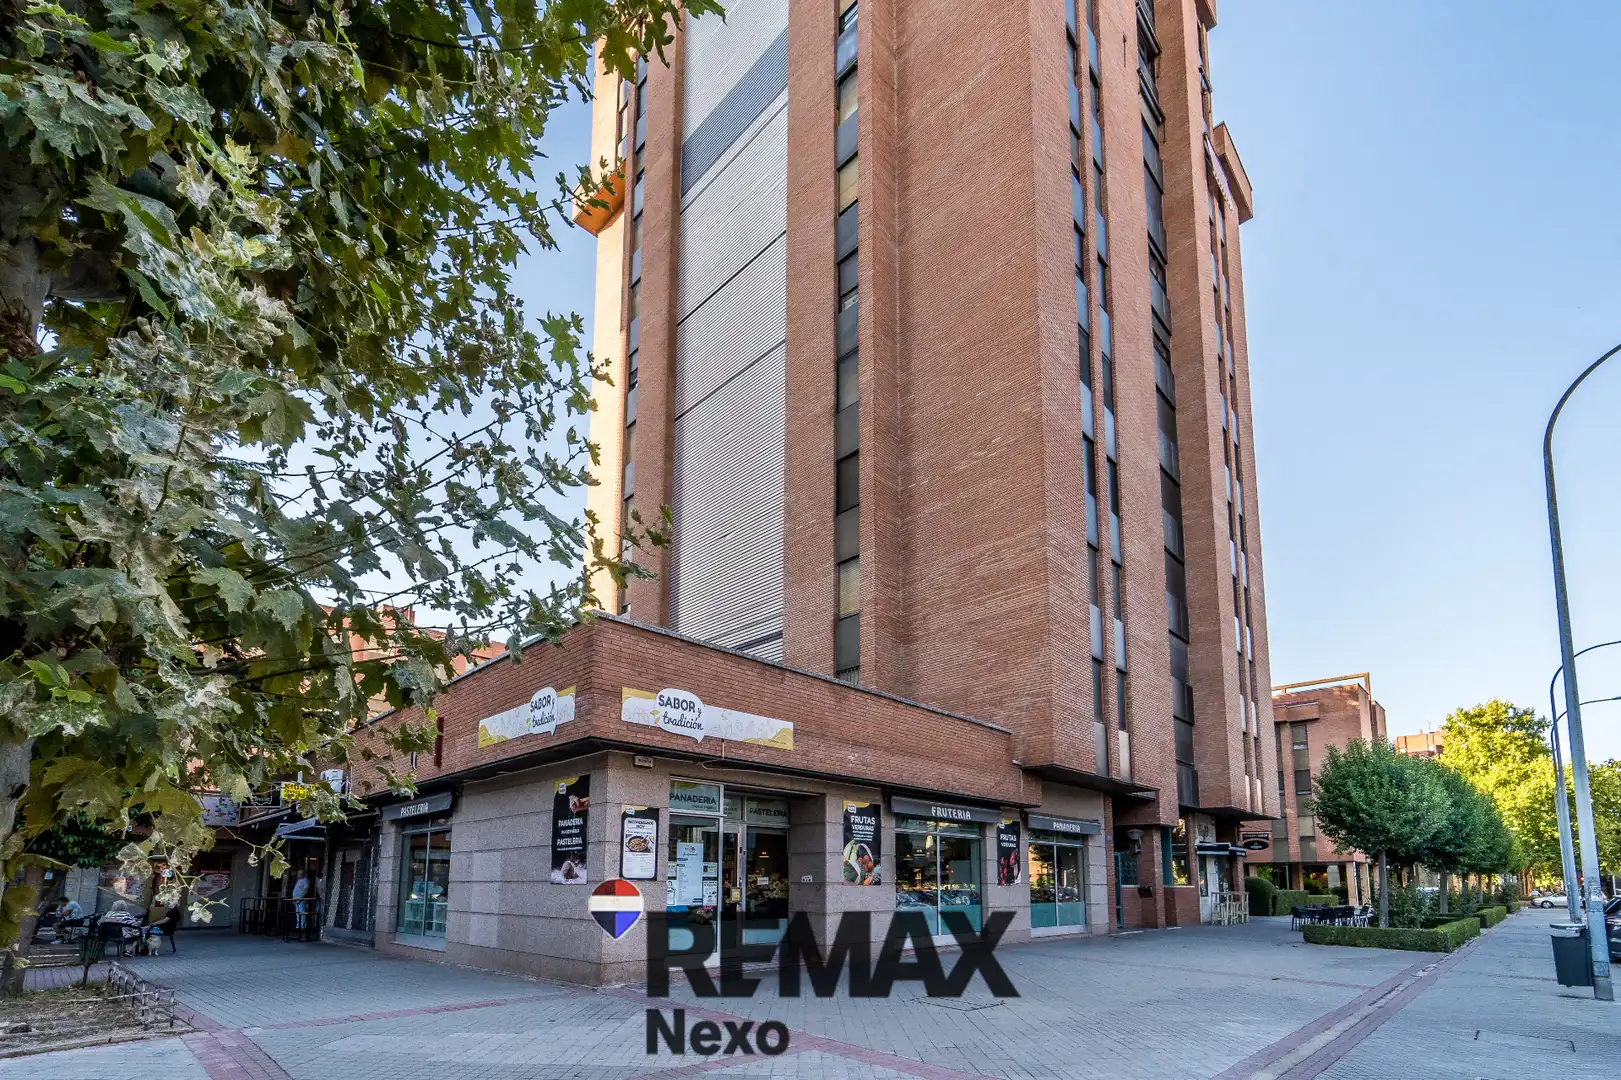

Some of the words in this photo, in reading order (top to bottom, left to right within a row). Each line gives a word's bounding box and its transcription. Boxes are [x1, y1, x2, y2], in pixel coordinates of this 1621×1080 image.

[530, 695, 551, 713] SABOR
[658, 694, 696, 713] SABOR
[696, 707, 702, 718] y
[662, 713, 704, 731] tradición
[669, 793, 717, 805] PANADERIA
[400, 802, 429, 817] PASTELERIA
[749, 808, 788, 817] PASTELERIA
[931, 806, 971, 820] FRUTERIA
[850, 815, 876, 825] FRUTAS
[851, 824, 875, 832] VERDURAS
[1053, 822, 1081, 833] PANADERIA
[556, 836, 583, 846] PASTELERIA
[1000, 833, 1017, 842] FRUTAS
